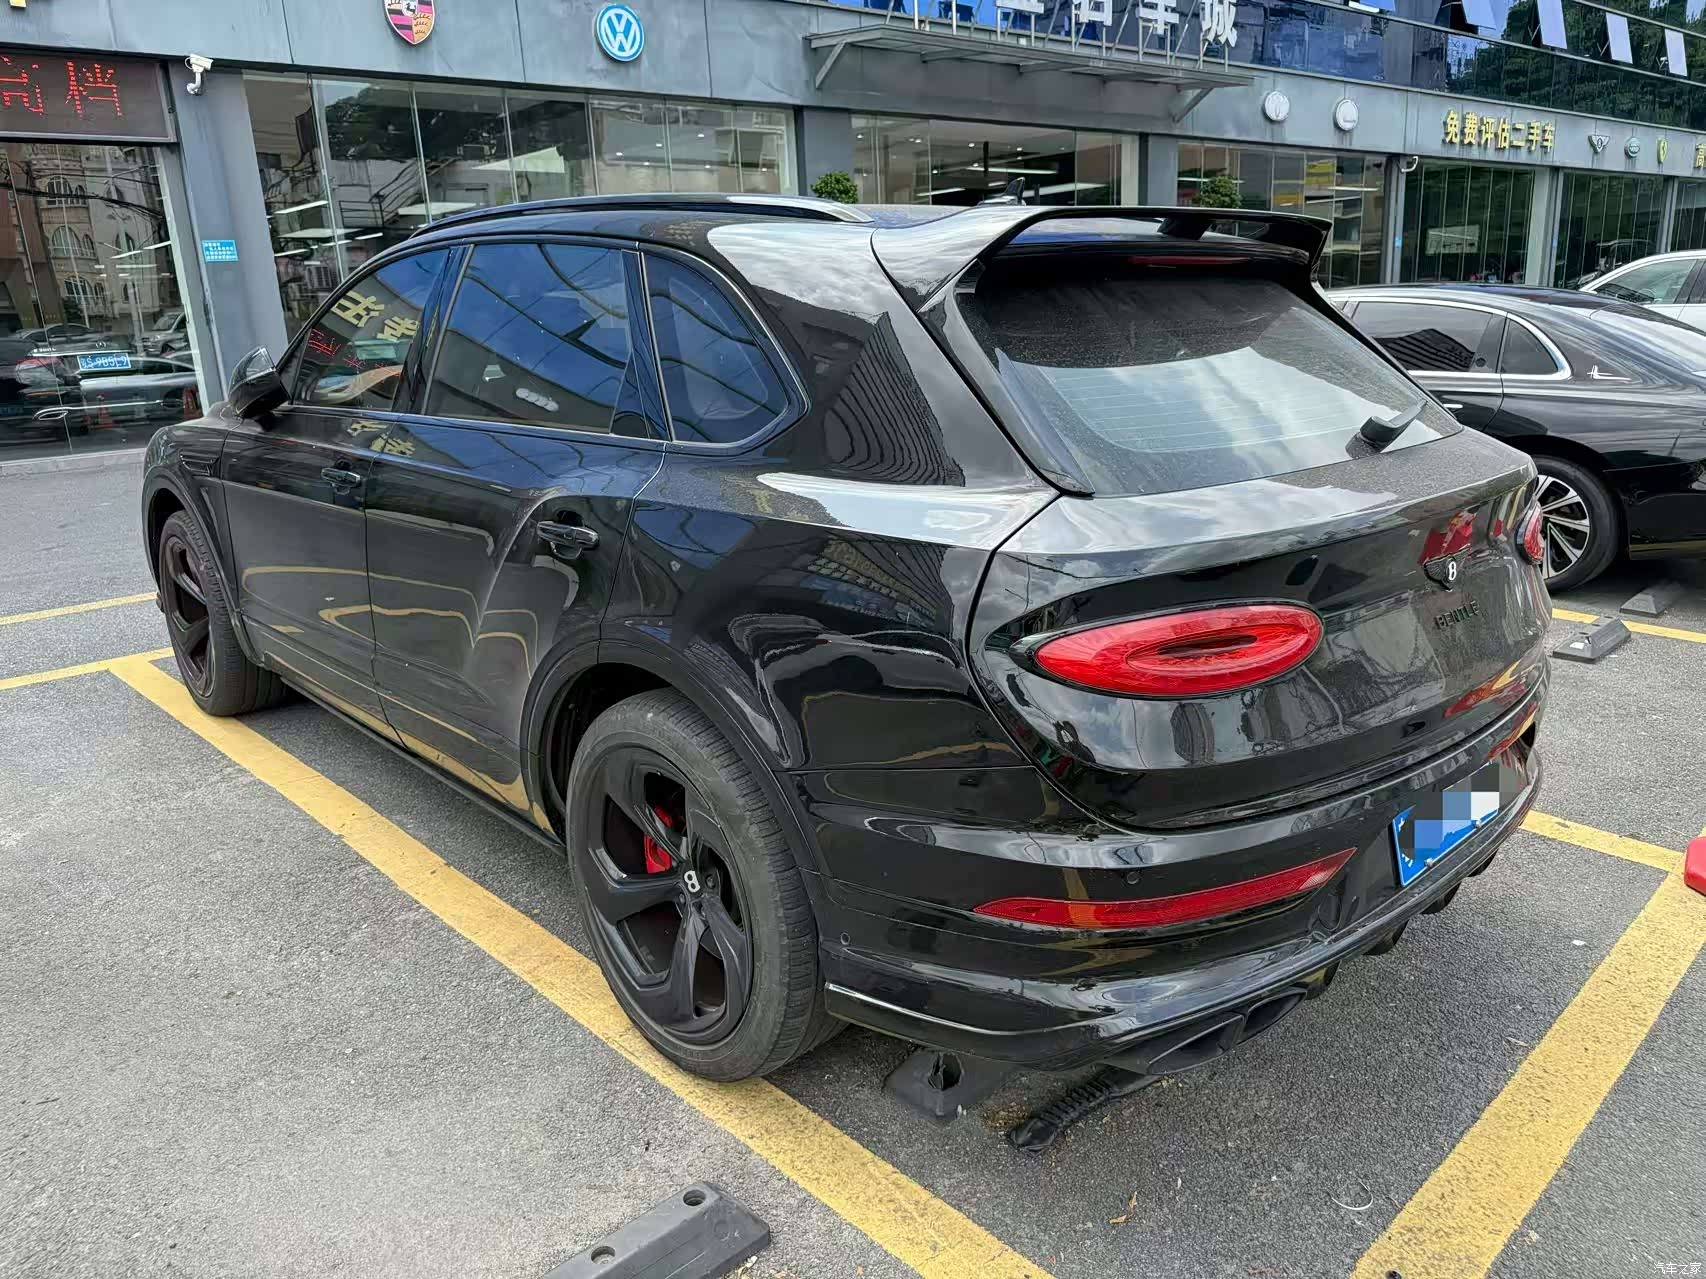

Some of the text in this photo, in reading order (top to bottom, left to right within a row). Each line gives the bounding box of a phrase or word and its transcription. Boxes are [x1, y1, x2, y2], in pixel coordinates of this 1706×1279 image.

[1444, 109, 1556, 153] 免费评估二手车
